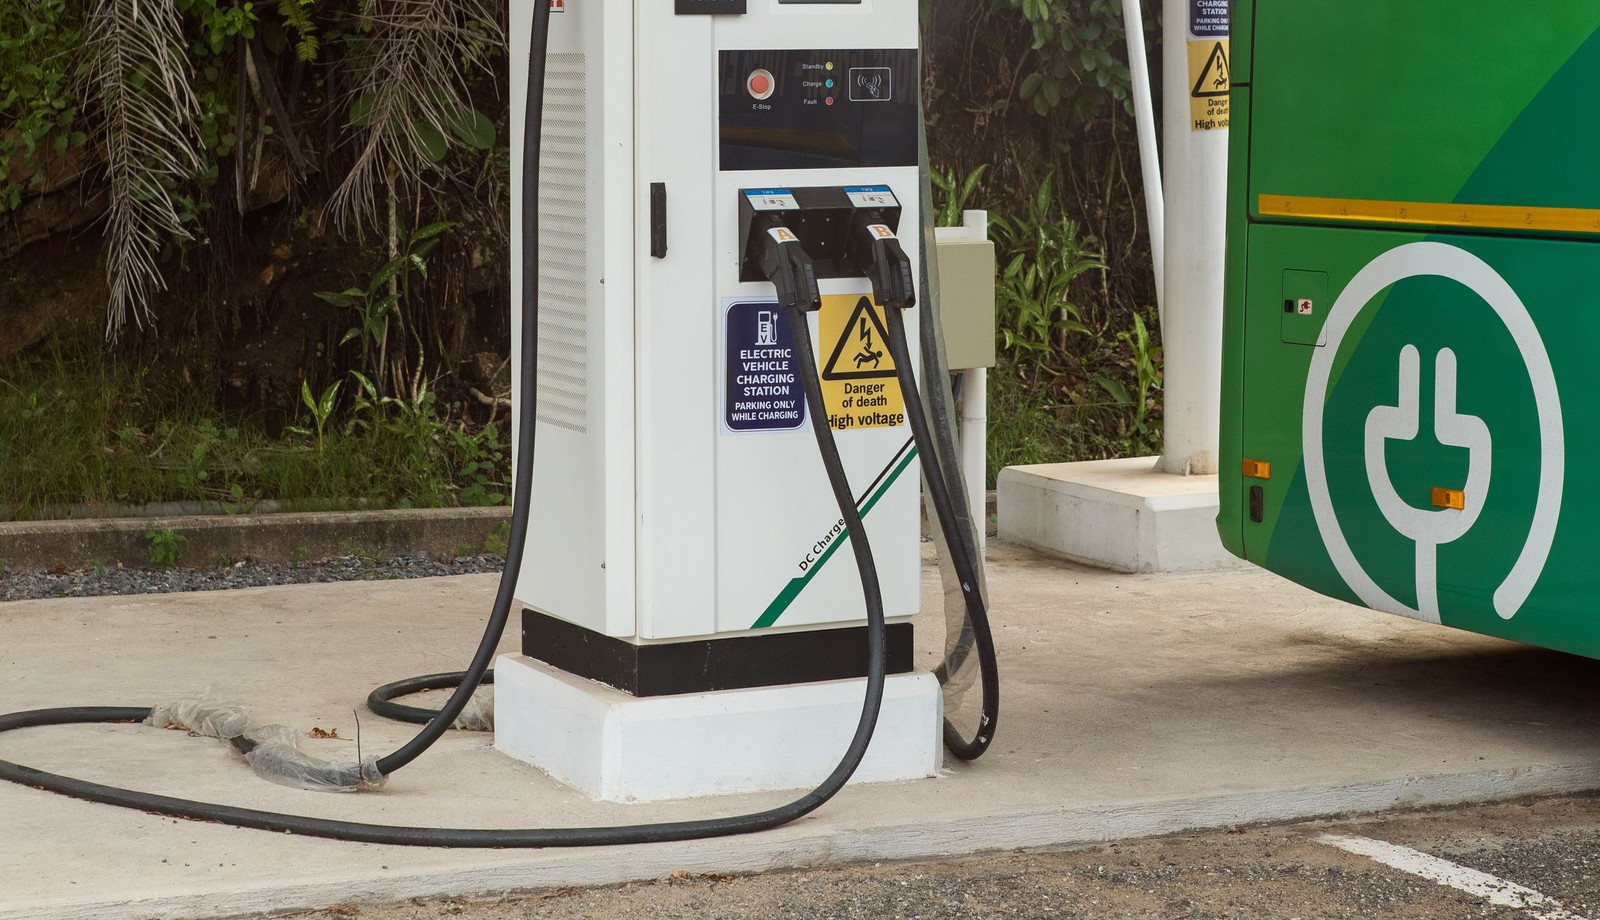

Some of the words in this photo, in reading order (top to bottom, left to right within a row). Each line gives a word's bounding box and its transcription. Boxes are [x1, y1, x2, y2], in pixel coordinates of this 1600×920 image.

[1207, 108, 1215, 116] of
[1195, 119, 1216, 130] High
[778, 229, 795, 241] A
[873, 226, 891, 237] B
[740, 348, 792, 359] ELECTRIC
[742, 360, 789, 371] VEHICLE
[736, 373, 795, 385] CHARGING
[743, 385, 790, 396] STATION
[844, 382, 885, 395] Danger
[735, 401, 772, 410] PARKING
[773, 400, 795, 409] ONLY
[842, 396, 853, 408] of
[856, 395, 887, 407] death
[731, 412, 757, 421] WHILE
[758, 410, 799, 420] CHARGING
[857, 411, 904, 427] voltage
[798, 553, 815, 571] DC
